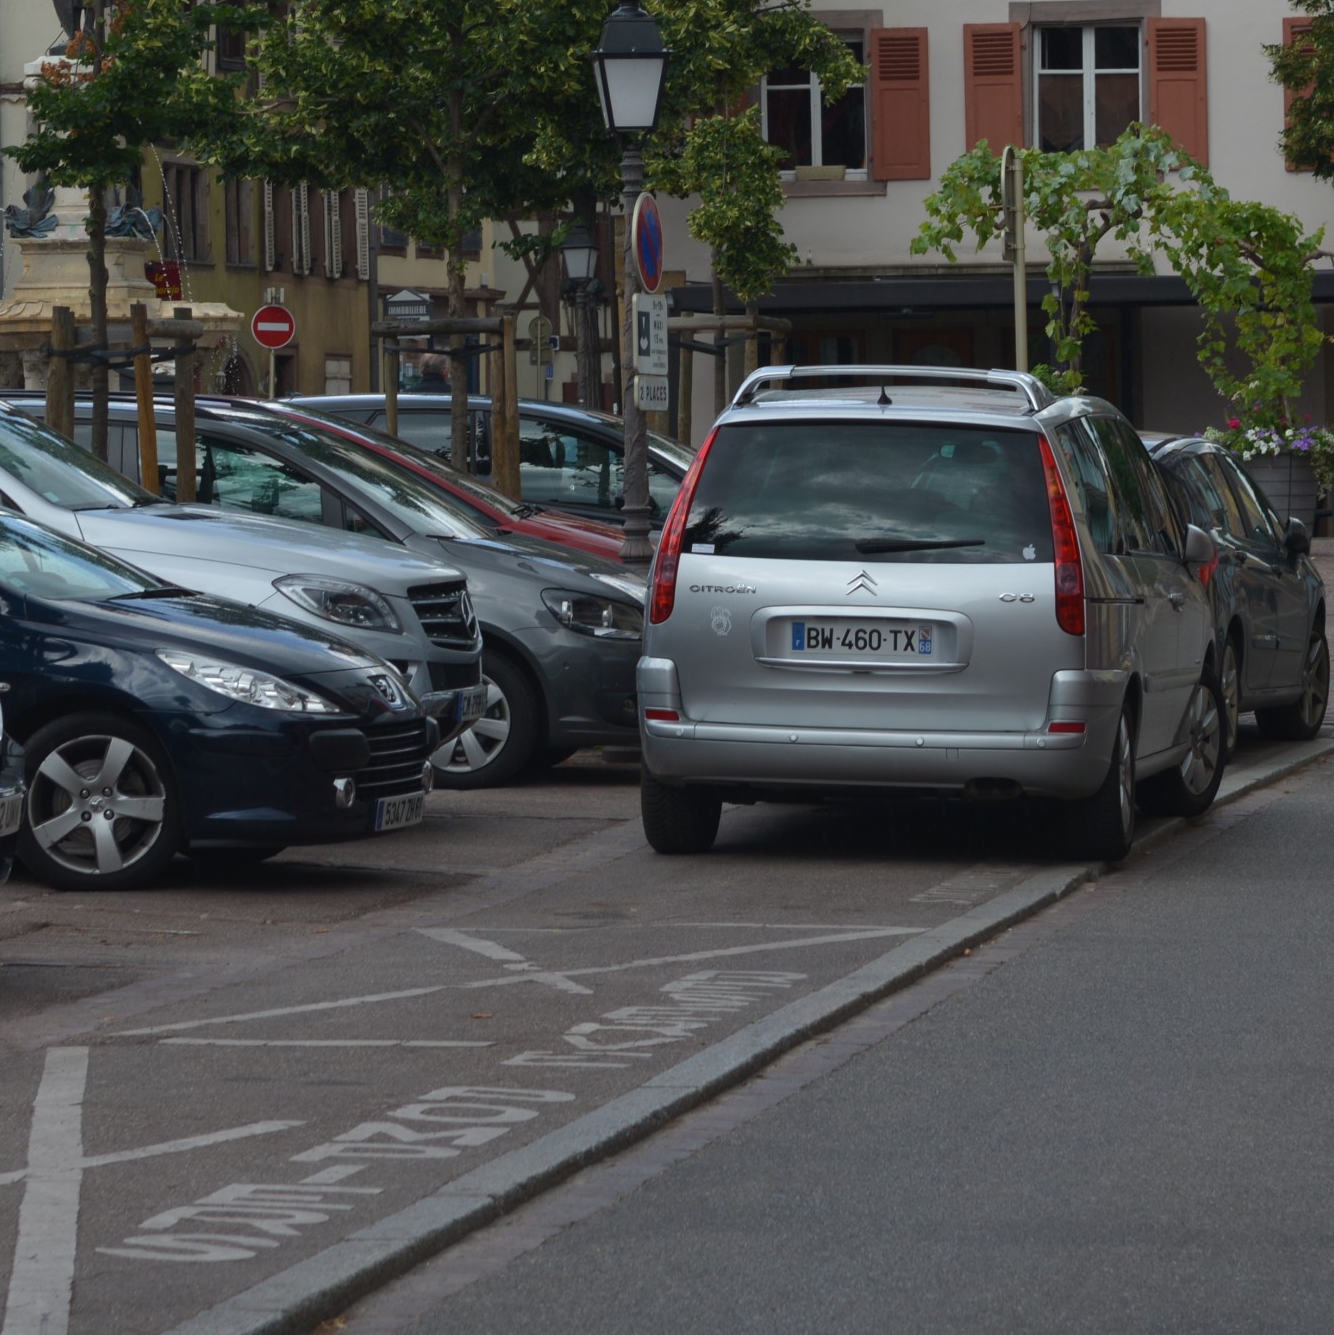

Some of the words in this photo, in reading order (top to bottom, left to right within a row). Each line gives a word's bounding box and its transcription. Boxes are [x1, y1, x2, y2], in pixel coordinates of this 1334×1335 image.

[640, 386, 644, 401] 2
[646, 386, 667, 402] PLACES
[689, 583, 757, 594] CITROËN
[998, 592, 1036, 603] C8
[806, 626, 916, 652] BW-460-TX
[919, 641, 932, 653] 68
